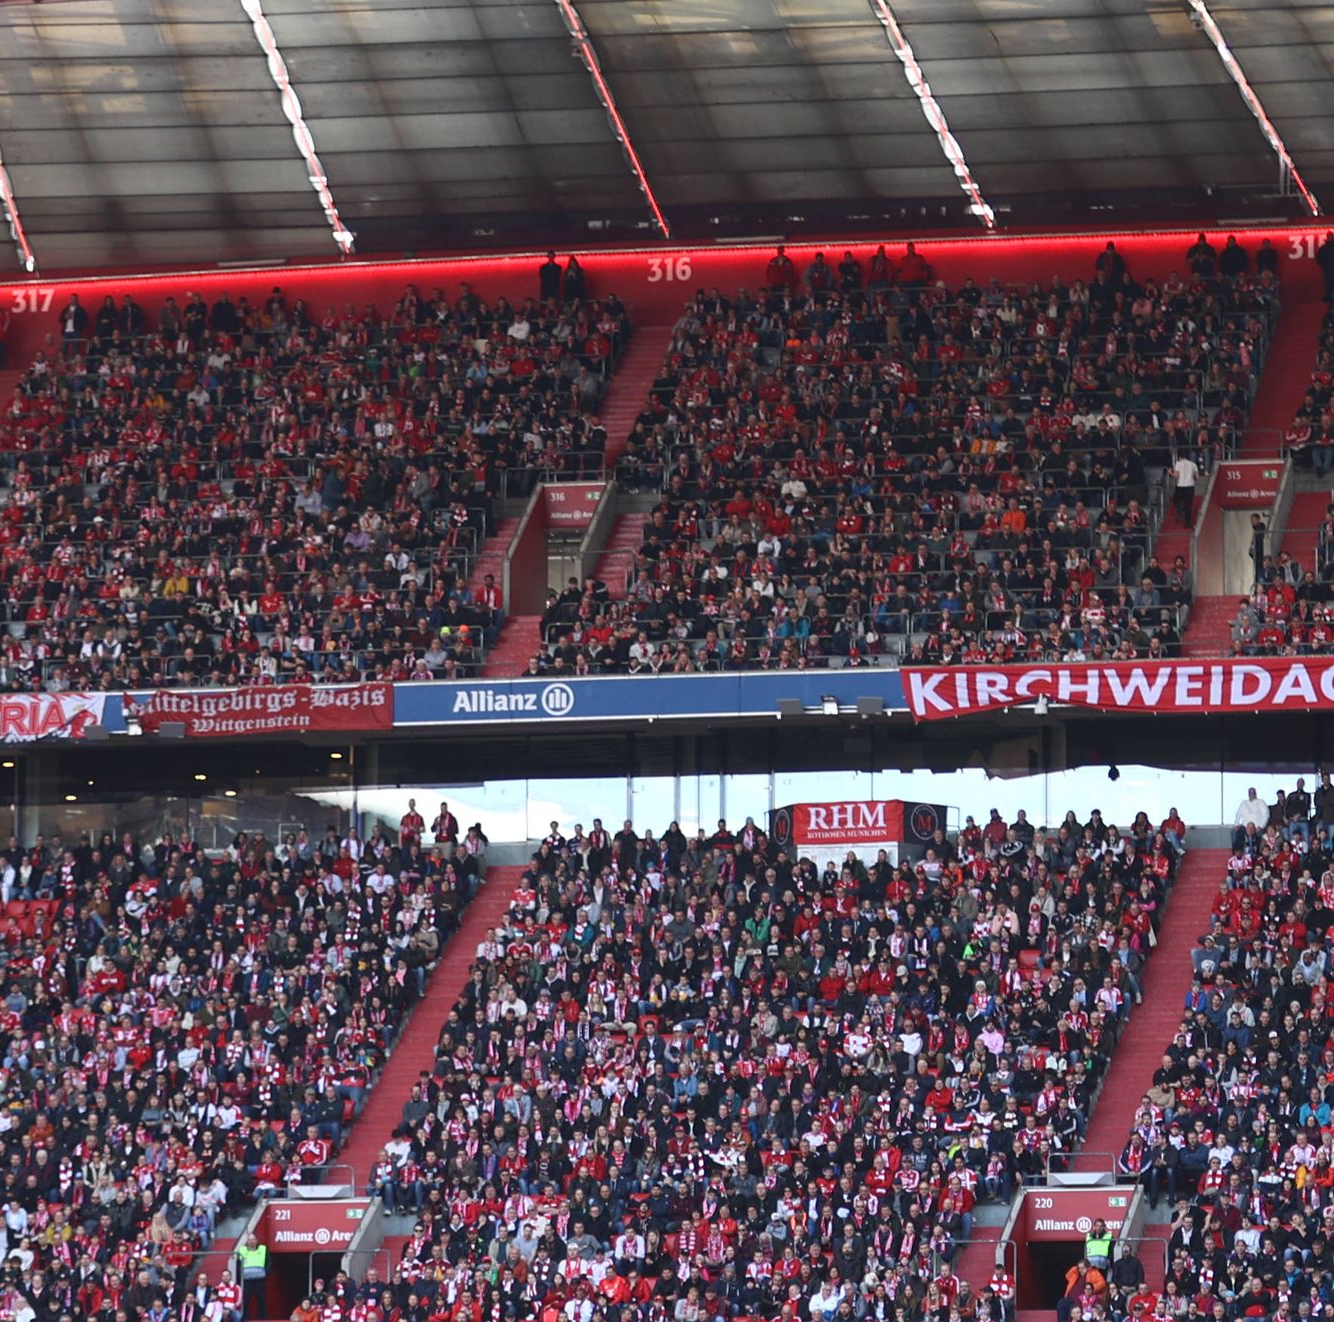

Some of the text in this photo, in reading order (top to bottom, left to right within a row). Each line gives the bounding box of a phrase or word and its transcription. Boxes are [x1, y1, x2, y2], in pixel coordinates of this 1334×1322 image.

[648, 257, 692, 281] 316
[12, 289, 55, 313] 317
[453, 691, 537, 713] Allianz
[192, 715, 310, 734] Wittgenstein
[807, 802, 888, 831] RHM
[1035, 1198, 1053, 1209] 220
[275, 1209, 290, 1220] 221
[1035, 1219, 1074, 1231] Allianz
[275, 1231, 312, 1242] Allianz
